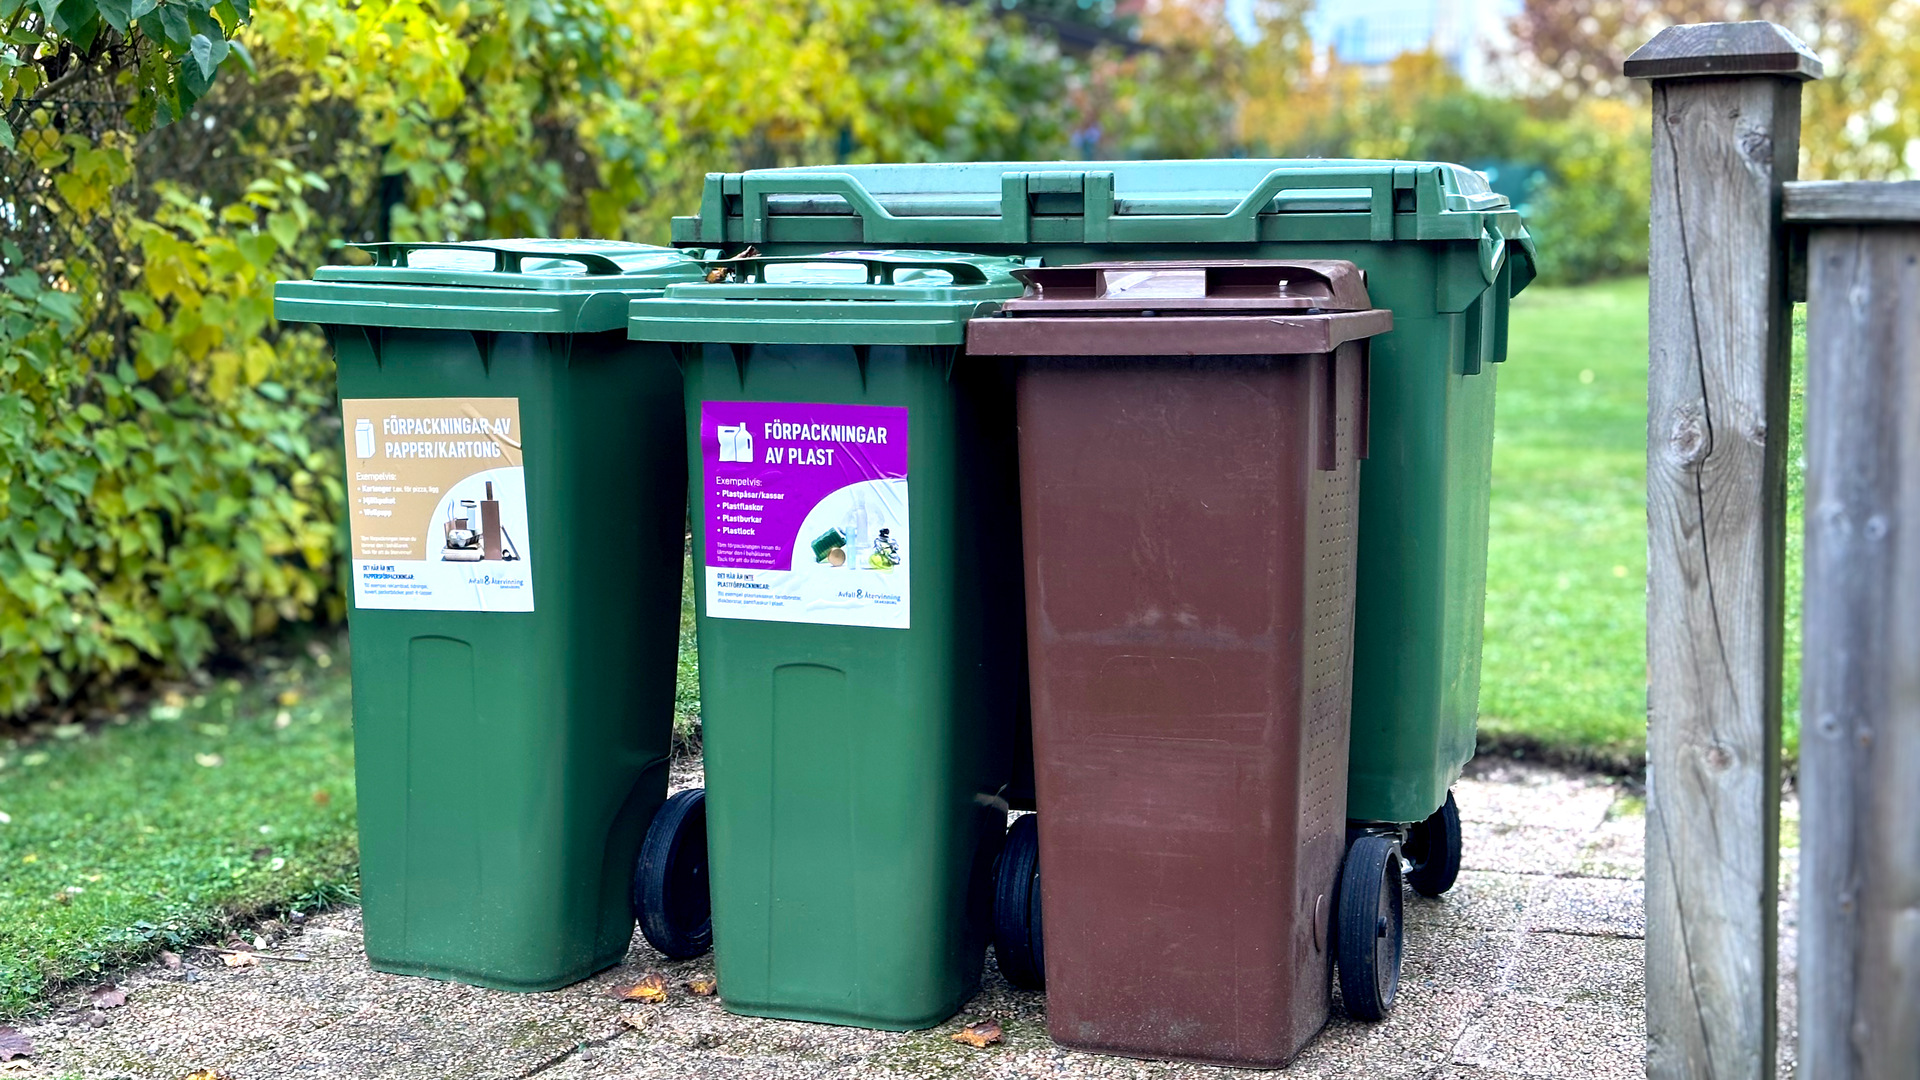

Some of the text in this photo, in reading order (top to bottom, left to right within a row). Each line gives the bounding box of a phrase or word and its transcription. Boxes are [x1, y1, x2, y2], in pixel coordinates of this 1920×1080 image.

[383, 415, 511, 435] FÖRPACKNINGAR AV
[764, 418, 888, 444] FÖRPACKNINGAR
[385, 441, 501, 458] PAPPER/KARTONG
[765, 446, 834, 466] AV PLAST
[356, 472, 397, 481] Exempelvis:
[716, 476, 763, 487] Exempelvis:
[722, 489, 785, 500] Plastpåsar/kassar
[722, 502, 764, 511] Plastflaskor
[722, 514, 763, 523] Plastburkar
[722, 526, 756, 536] Plastlock
[864, 591, 901, 602] Återvinning
